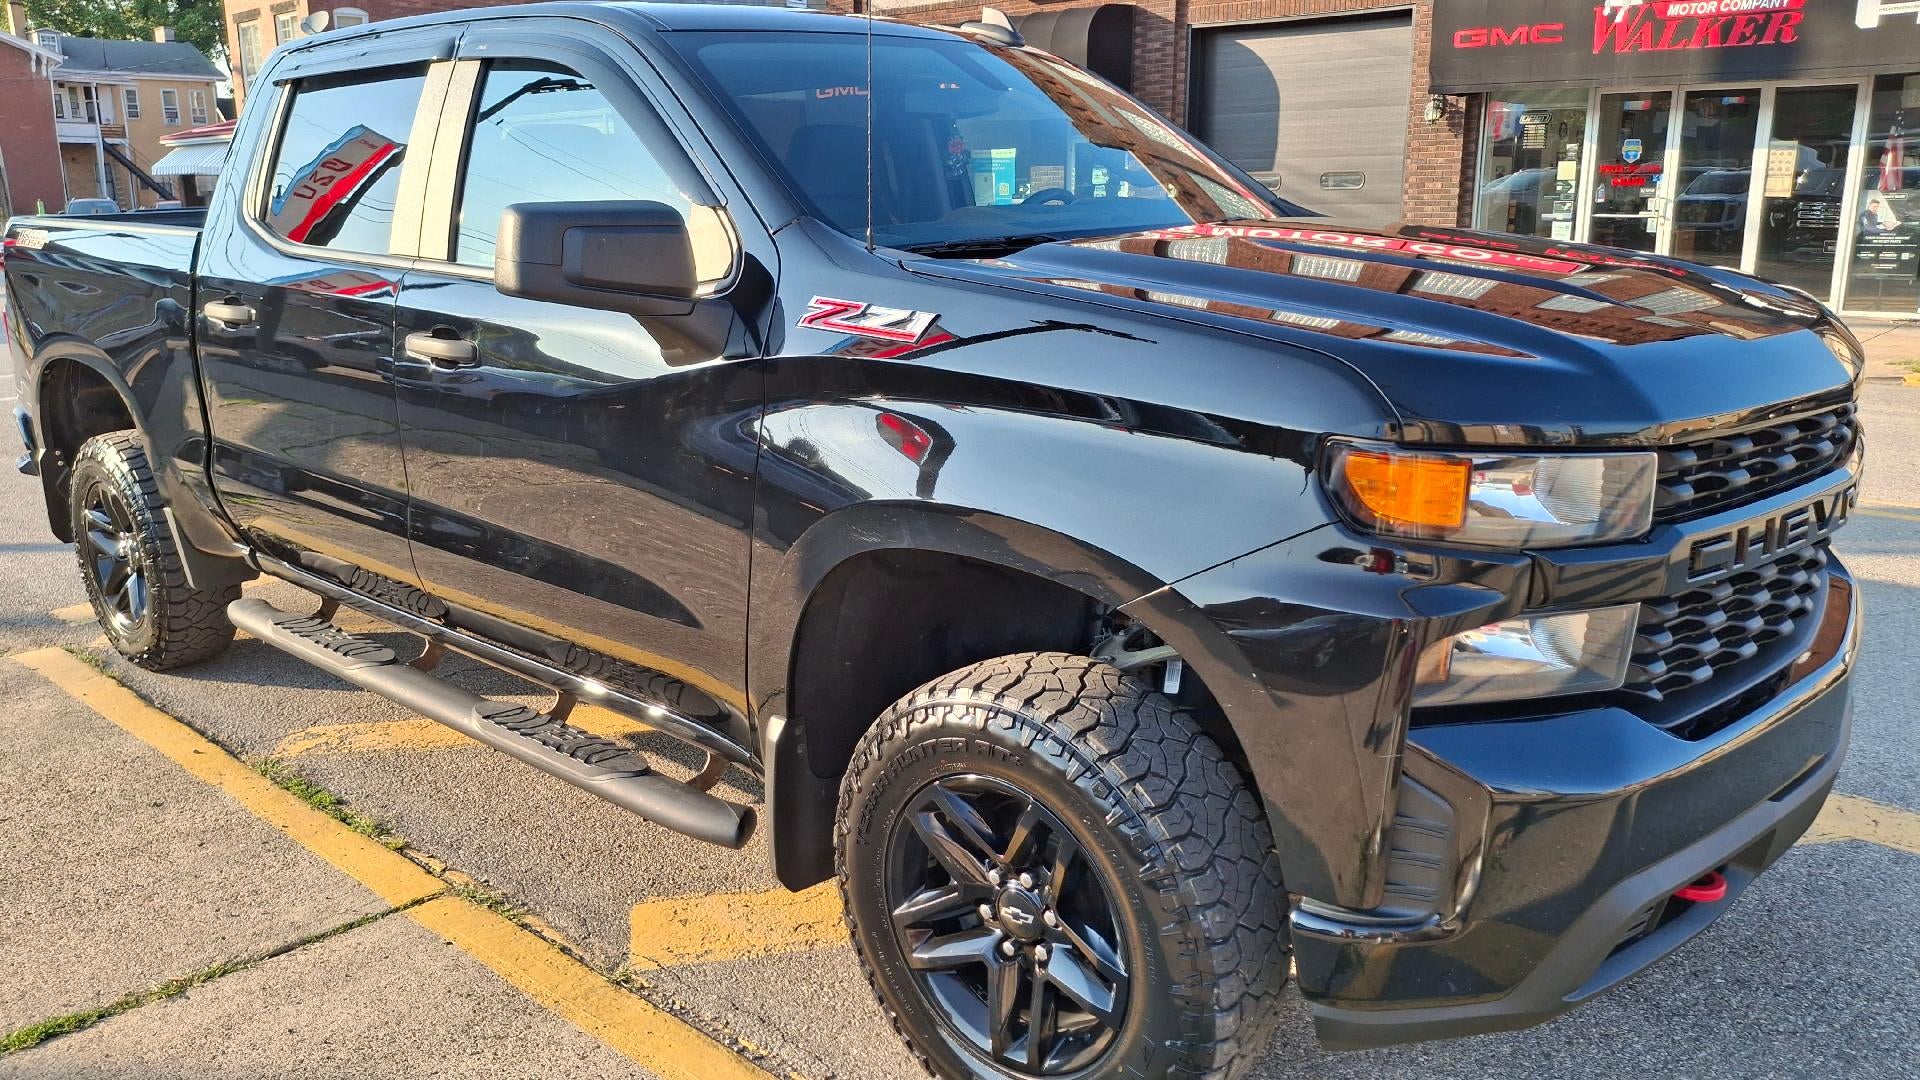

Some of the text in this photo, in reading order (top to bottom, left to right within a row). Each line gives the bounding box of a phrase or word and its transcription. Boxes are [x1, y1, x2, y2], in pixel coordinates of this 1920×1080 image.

[1667, 0, 1790, 16] MOTOR COMPANY
[1453, 23, 1565, 48] GMC
[1593, 3, 1804, 54] WALKER
[1521, 113, 1550, 122] OPEN
[795, 294, 942, 344] Z71
[887, 737, 969, 776] HUNTER
